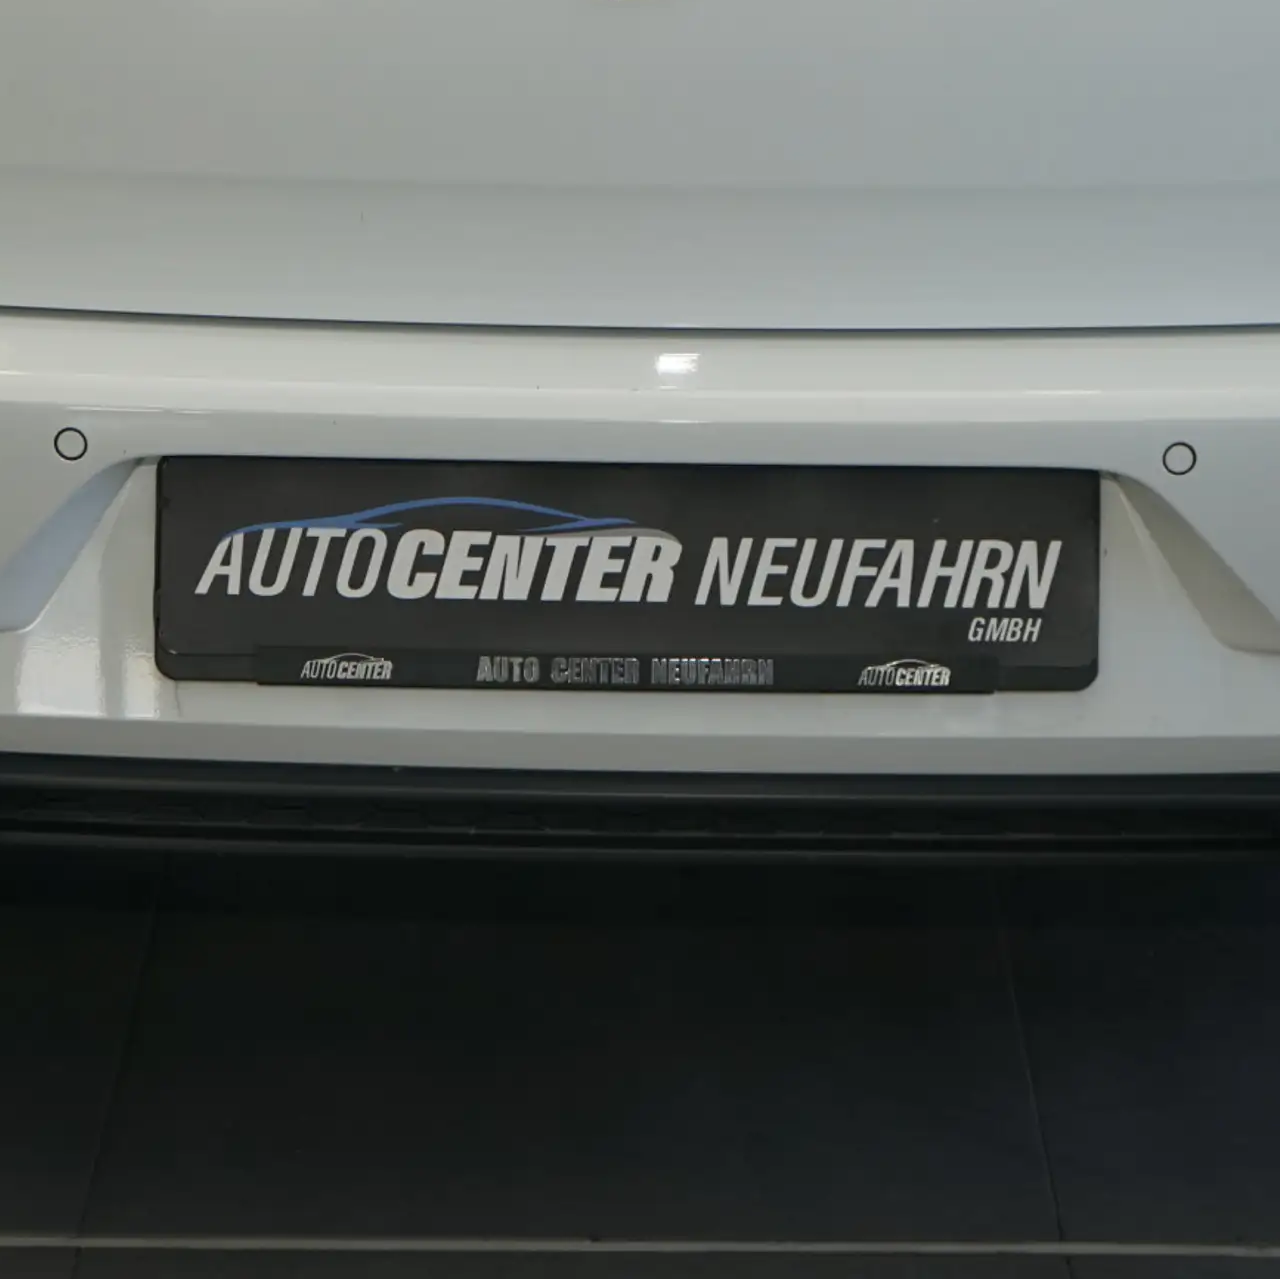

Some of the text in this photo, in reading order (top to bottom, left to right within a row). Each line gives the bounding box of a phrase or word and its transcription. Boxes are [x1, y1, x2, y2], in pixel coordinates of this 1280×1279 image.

[694, 536, 1062, 610] NEUFAHRN
[967, 616, 1042, 643] GMBH
[476, 656, 774, 685] AUTO CENTER NEUFAHRN
